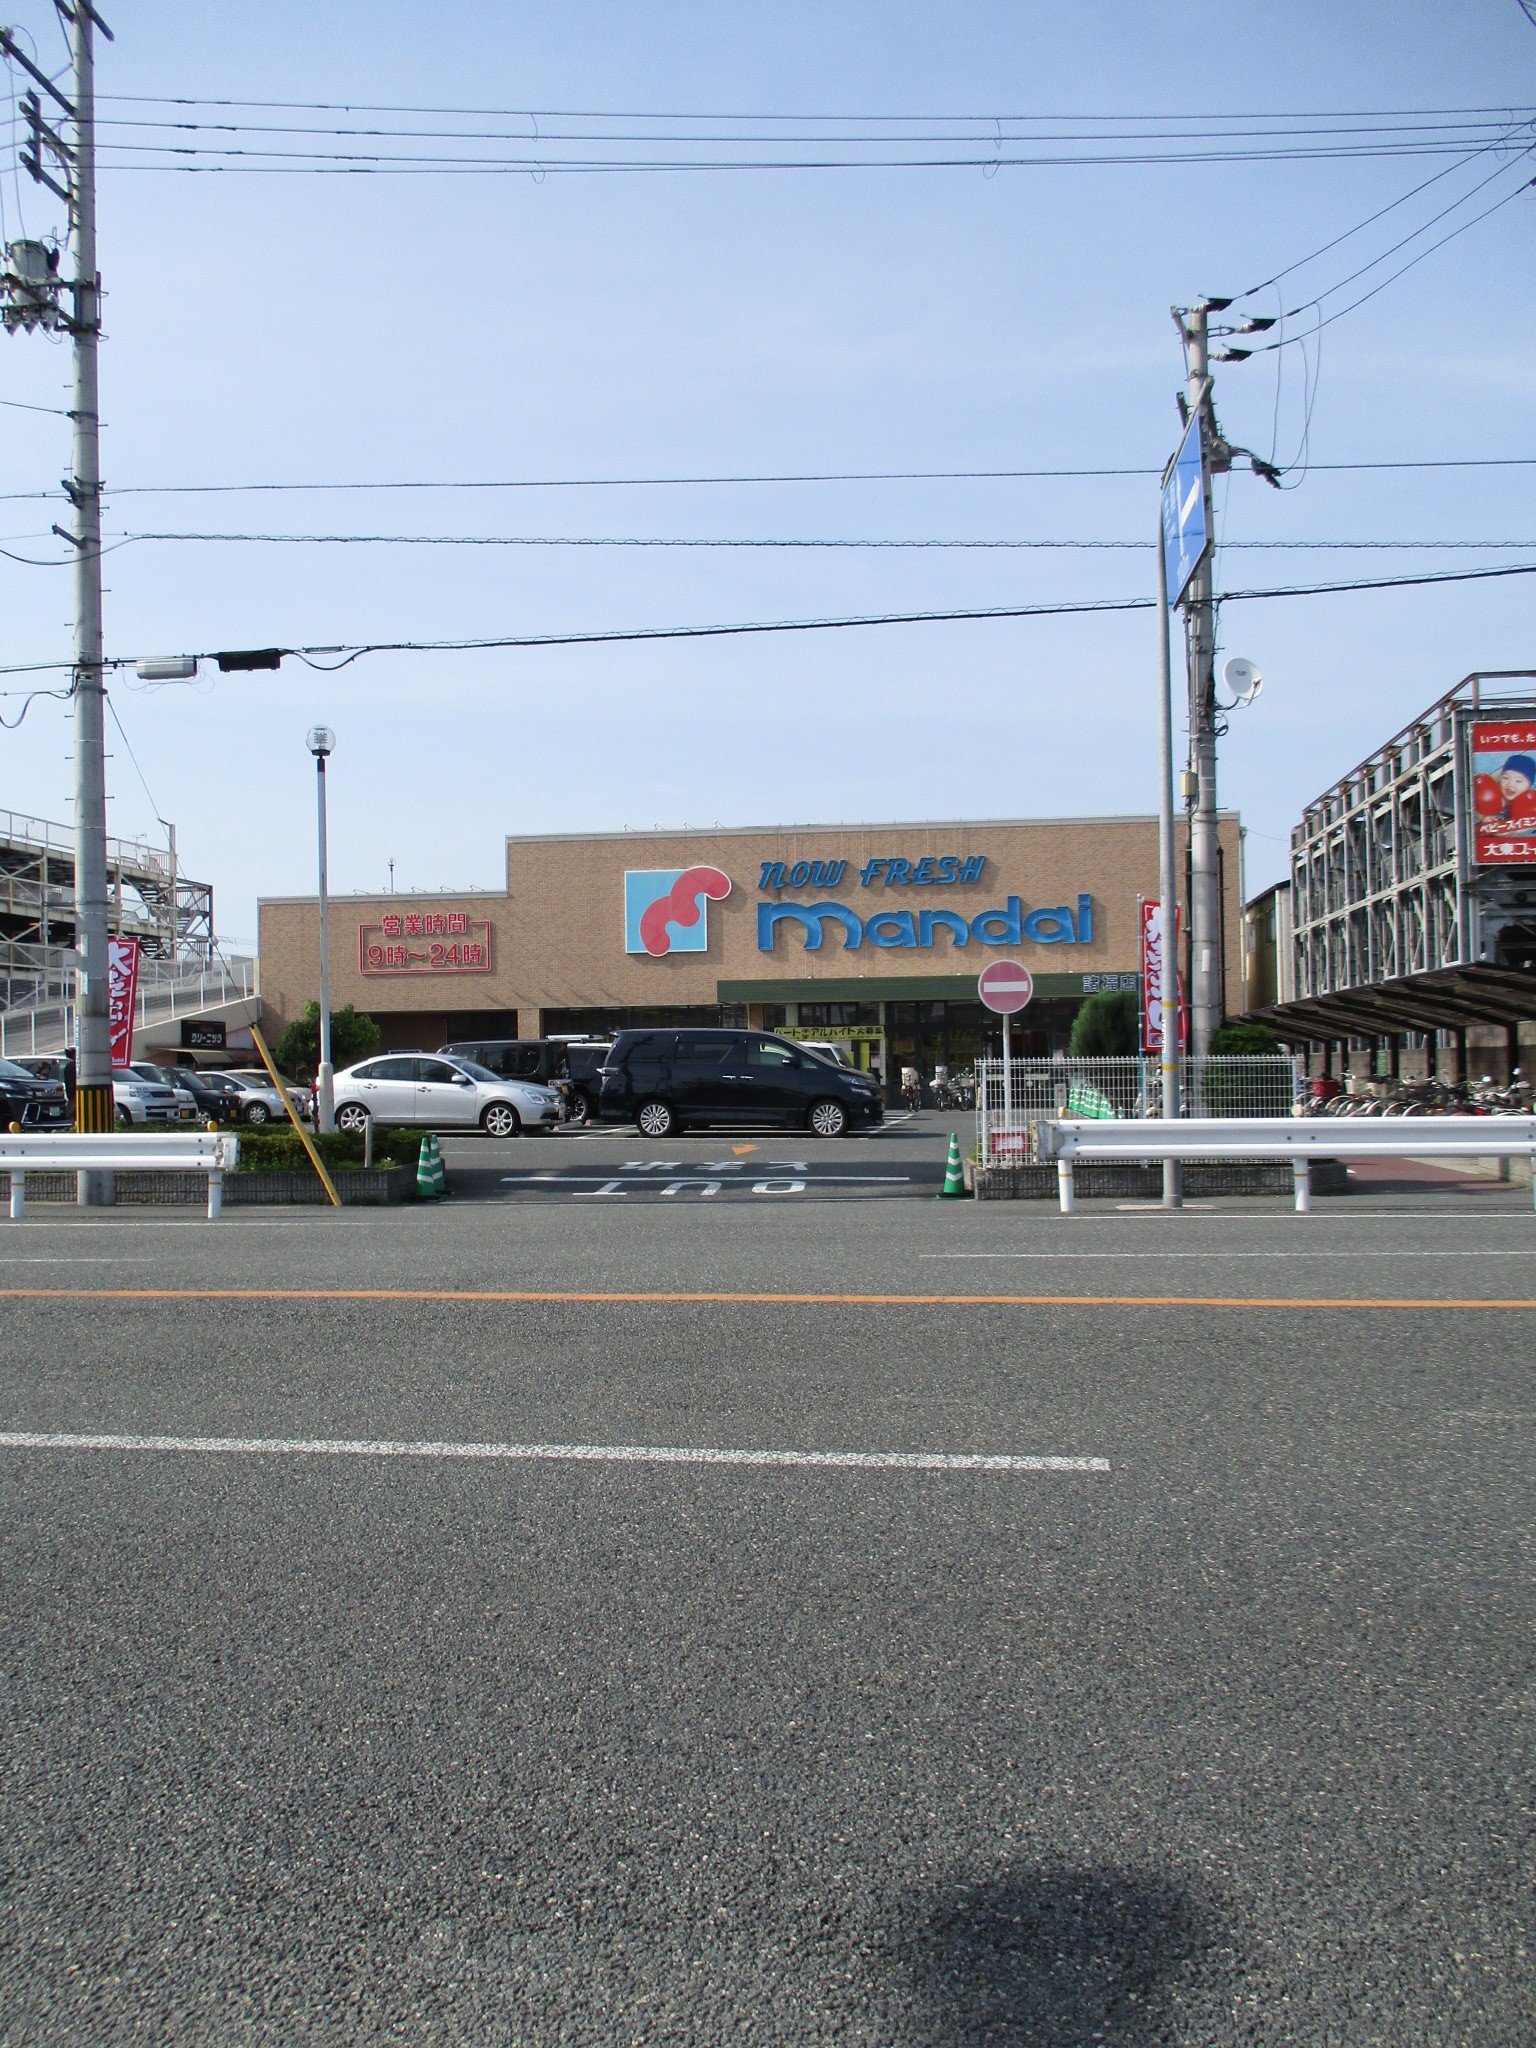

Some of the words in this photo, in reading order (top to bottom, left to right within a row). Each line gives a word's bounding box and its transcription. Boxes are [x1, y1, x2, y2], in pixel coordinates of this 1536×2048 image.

[859, 855, 986, 887] FRESH
[382, 913, 467, 936] 営業時間
[757, 893, 1094, 951] mandai
[1083, 974, 1137, 992] 諸福店
[191, 1032, 223, 1044] クリーニング
[572, 1179, 808, 1197] OUT
